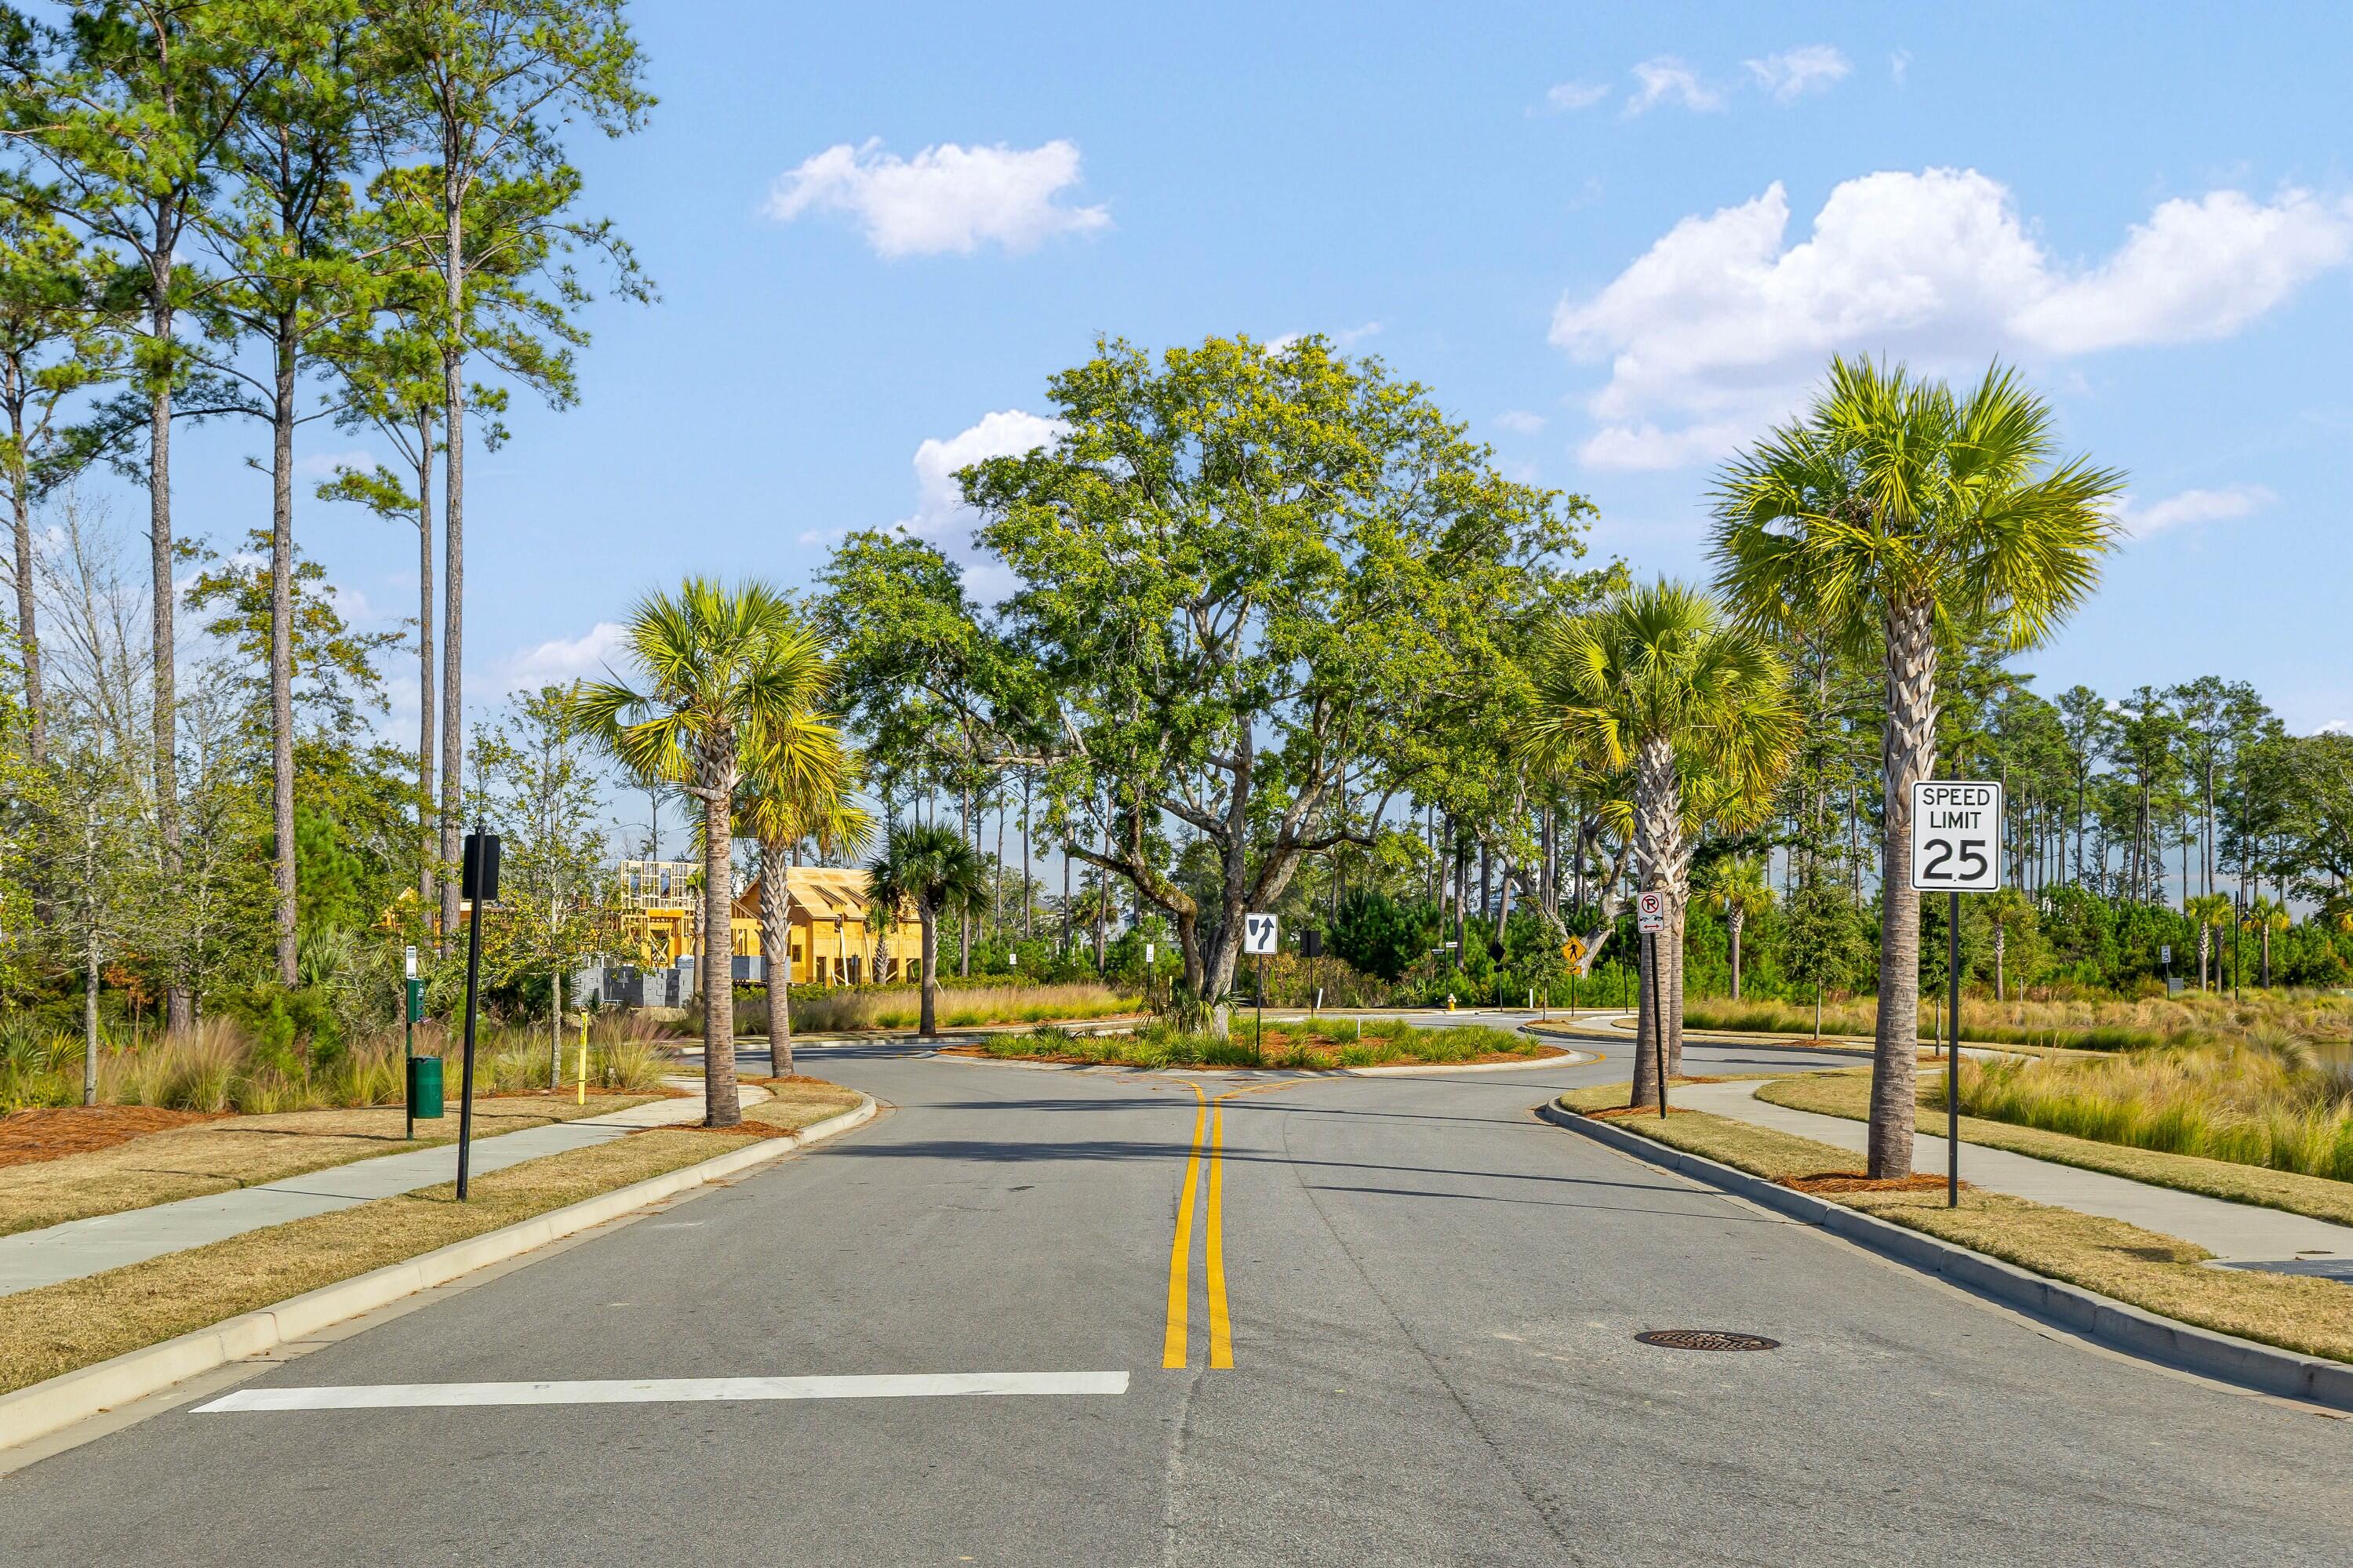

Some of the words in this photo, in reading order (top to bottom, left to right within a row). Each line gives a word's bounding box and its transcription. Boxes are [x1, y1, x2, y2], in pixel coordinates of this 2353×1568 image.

[1922, 788, 1990, 806] SPEED
[1930, 811, 1981, 829] LIMIT
[1923, 839, 1988, 881] 25
[1647, 898, 1656, 910] P
